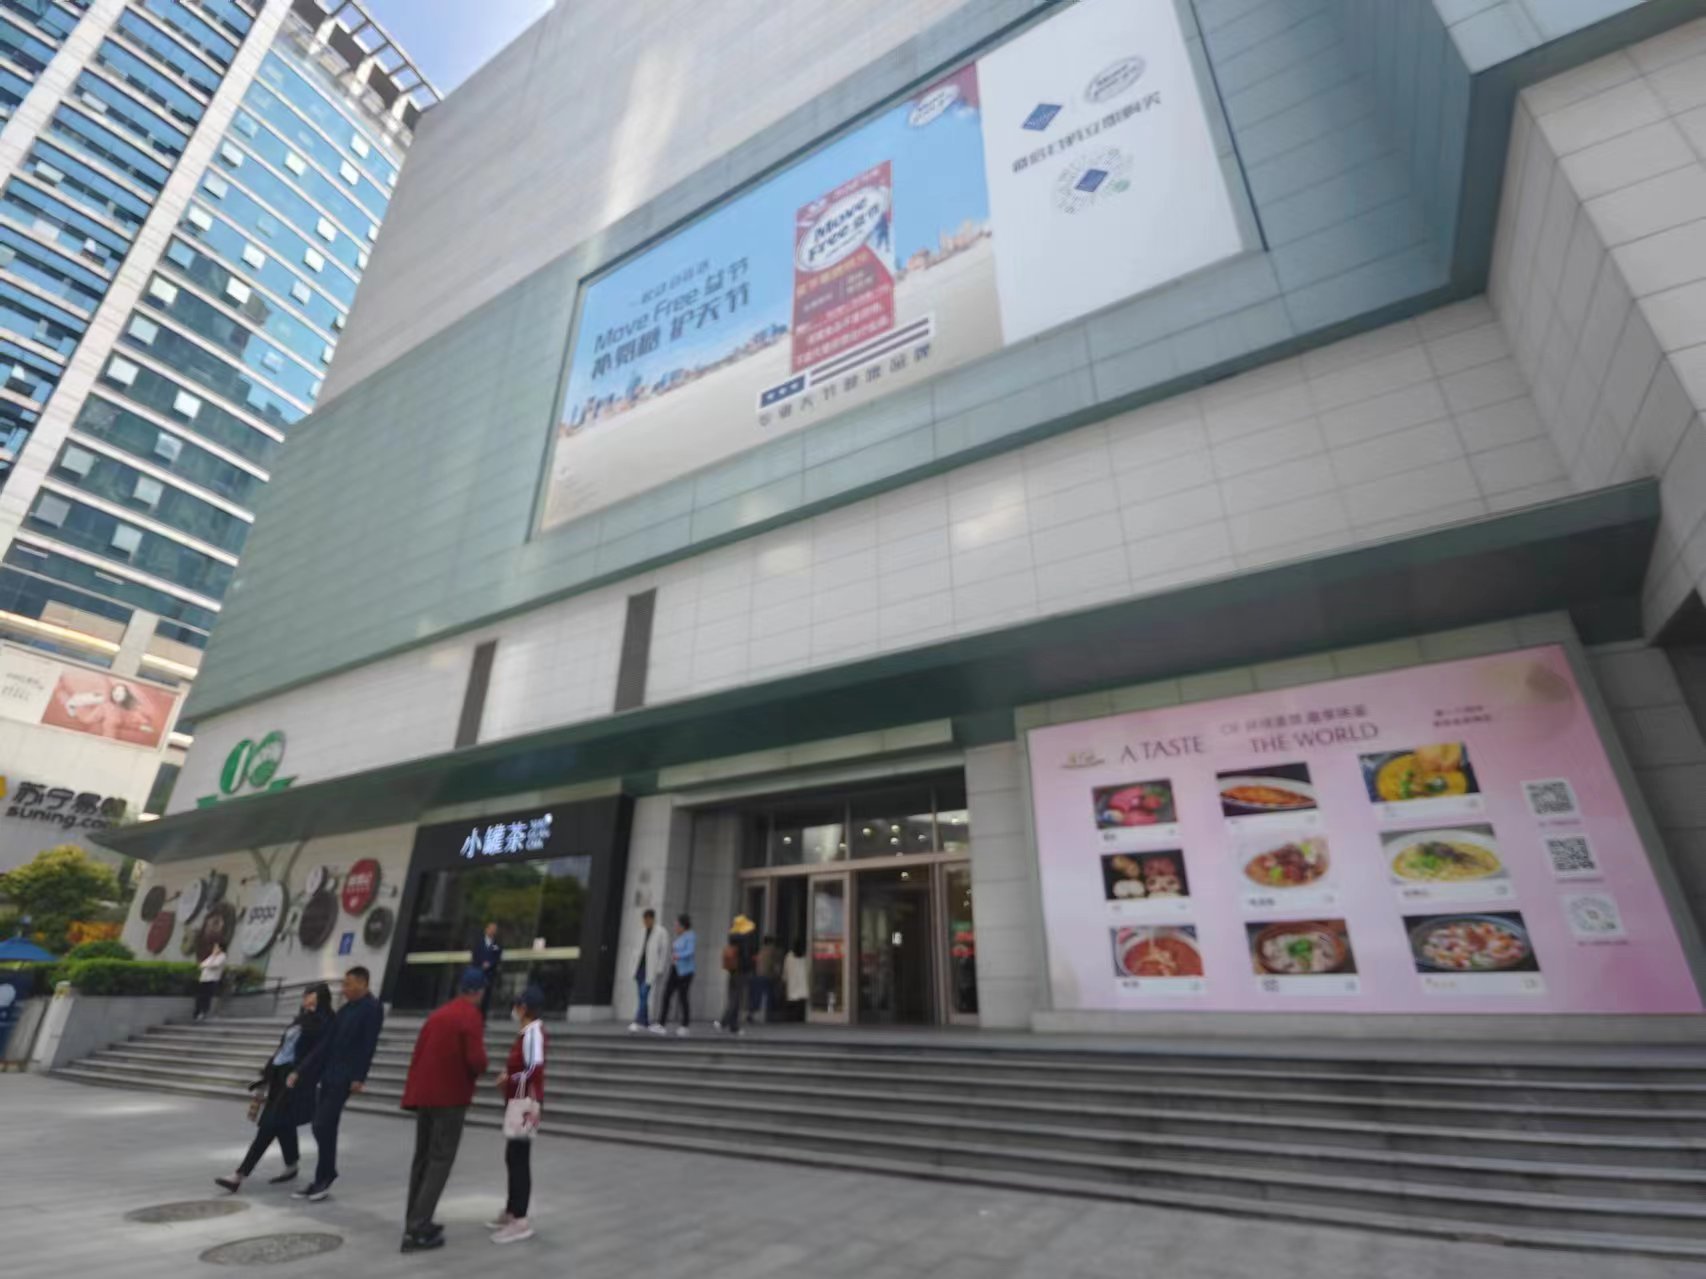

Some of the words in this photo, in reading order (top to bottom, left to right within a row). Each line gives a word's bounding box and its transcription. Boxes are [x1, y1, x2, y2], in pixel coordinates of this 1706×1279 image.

[594, 313, 649, 353] Move
[653, 287, 700, 323] Free
[1120, 744, 1138, 764] A
[1140, 735, 1207, 760] TASTE
[1251, 733, 1289, 753] THE
[1293, 721, 1379, 748] WORLD
[460, 821, 528, 859] 小罐茶
